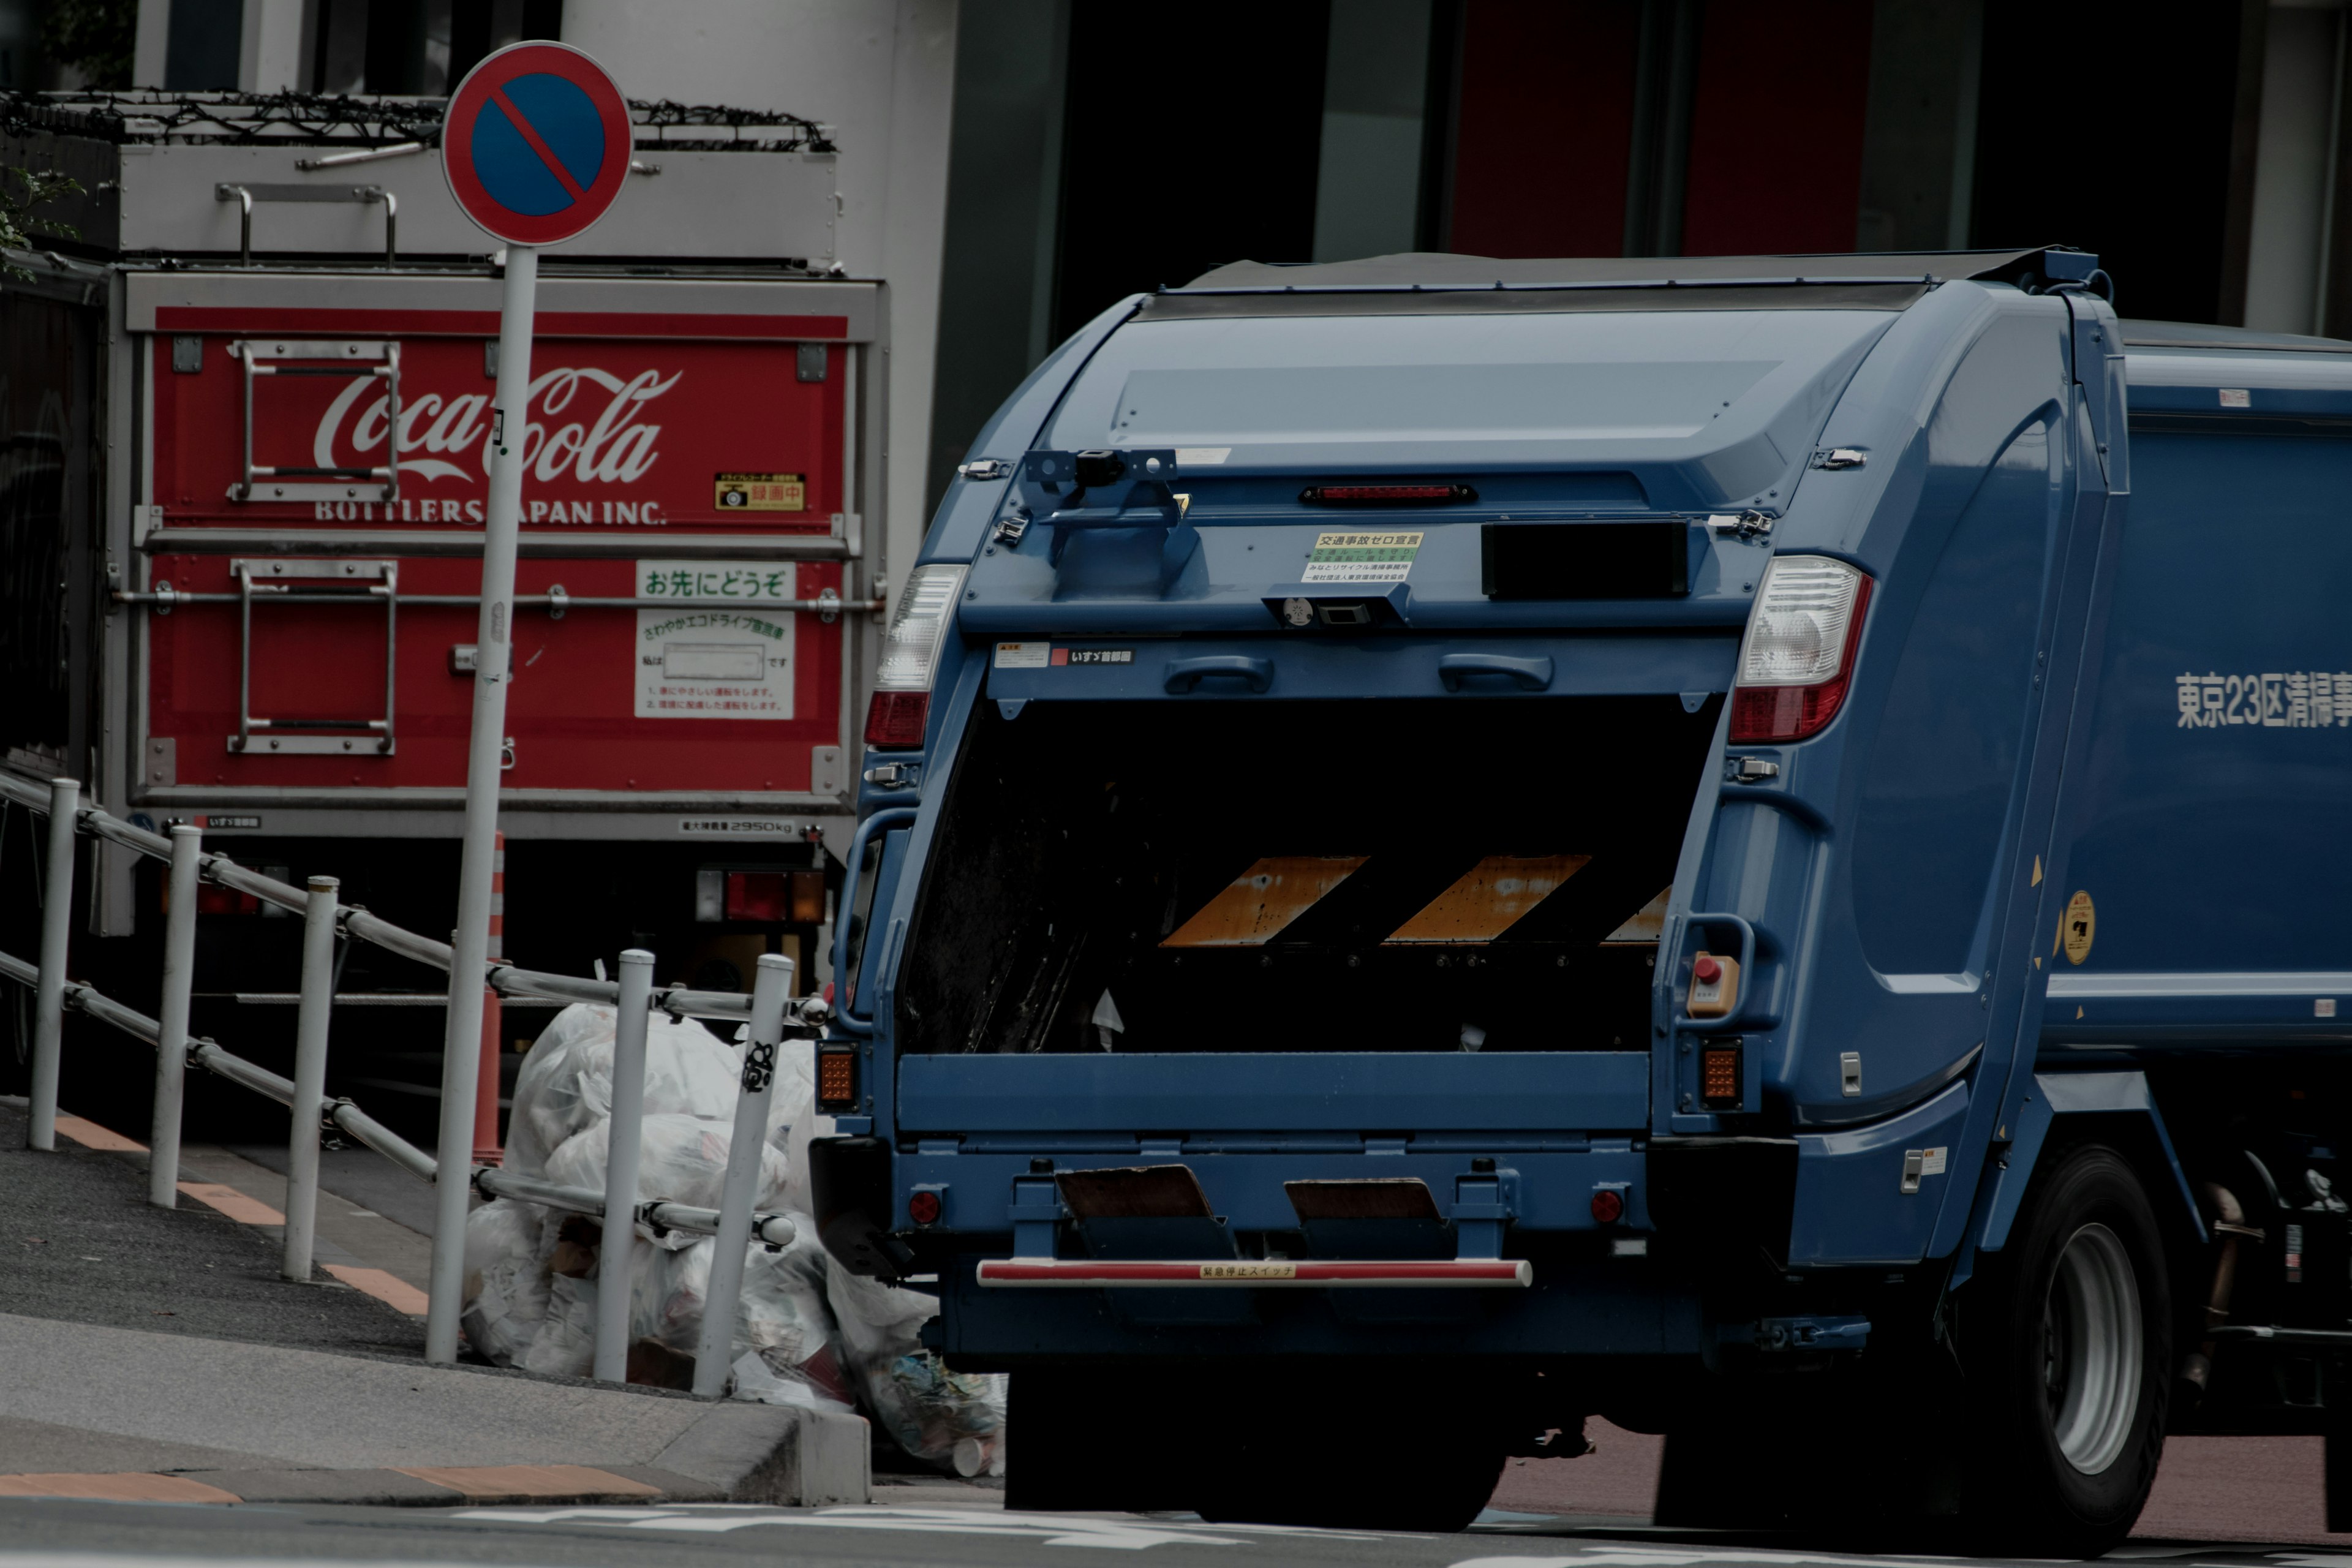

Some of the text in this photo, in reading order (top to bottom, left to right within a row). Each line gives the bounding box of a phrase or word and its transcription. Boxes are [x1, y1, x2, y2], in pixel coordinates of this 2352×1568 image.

[752, 484, 800, 501] 録画中
[314, 499, 485, 525] BOTTLERS
[601, 501, 667, 526] INC.
[1319, 535, 1420, 546] 交通事故ゼロ宣言
[645, 570, 786, 597] お先にどうぞ
[643, 614, 785, 641] さわやかエコドライブ宣言車
[767, 658, 787, 668] です
[1204, 1267, 1292, 1276] 緊急停止スイッチ
